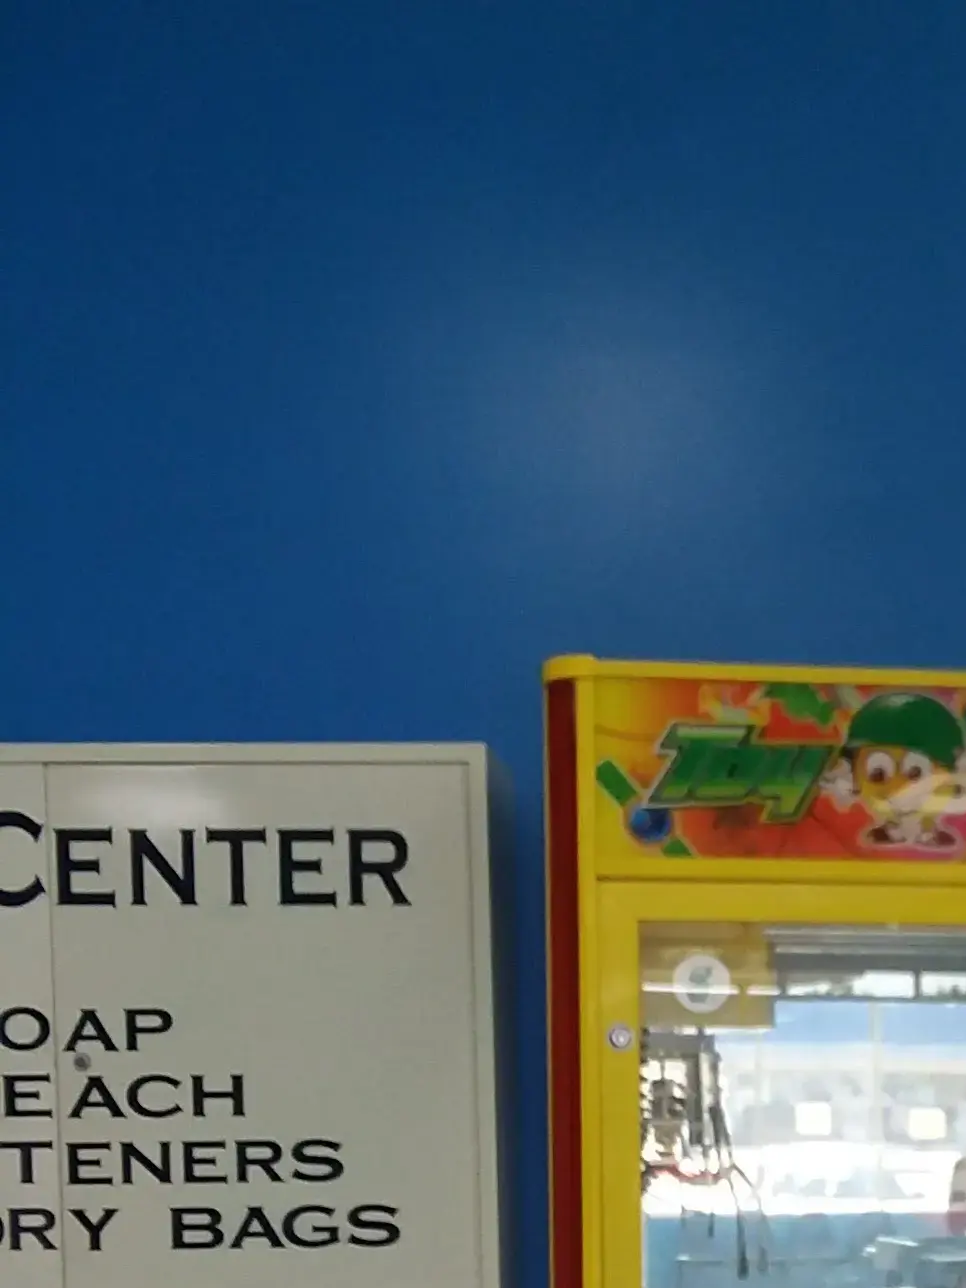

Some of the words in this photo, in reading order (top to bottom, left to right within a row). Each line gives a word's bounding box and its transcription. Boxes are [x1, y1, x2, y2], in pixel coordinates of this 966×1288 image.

[2, 1072, 246, 1119] EACH
[0, 1207, 119, 1252] RY
[170, 1204, 401, 1250] BAGS
